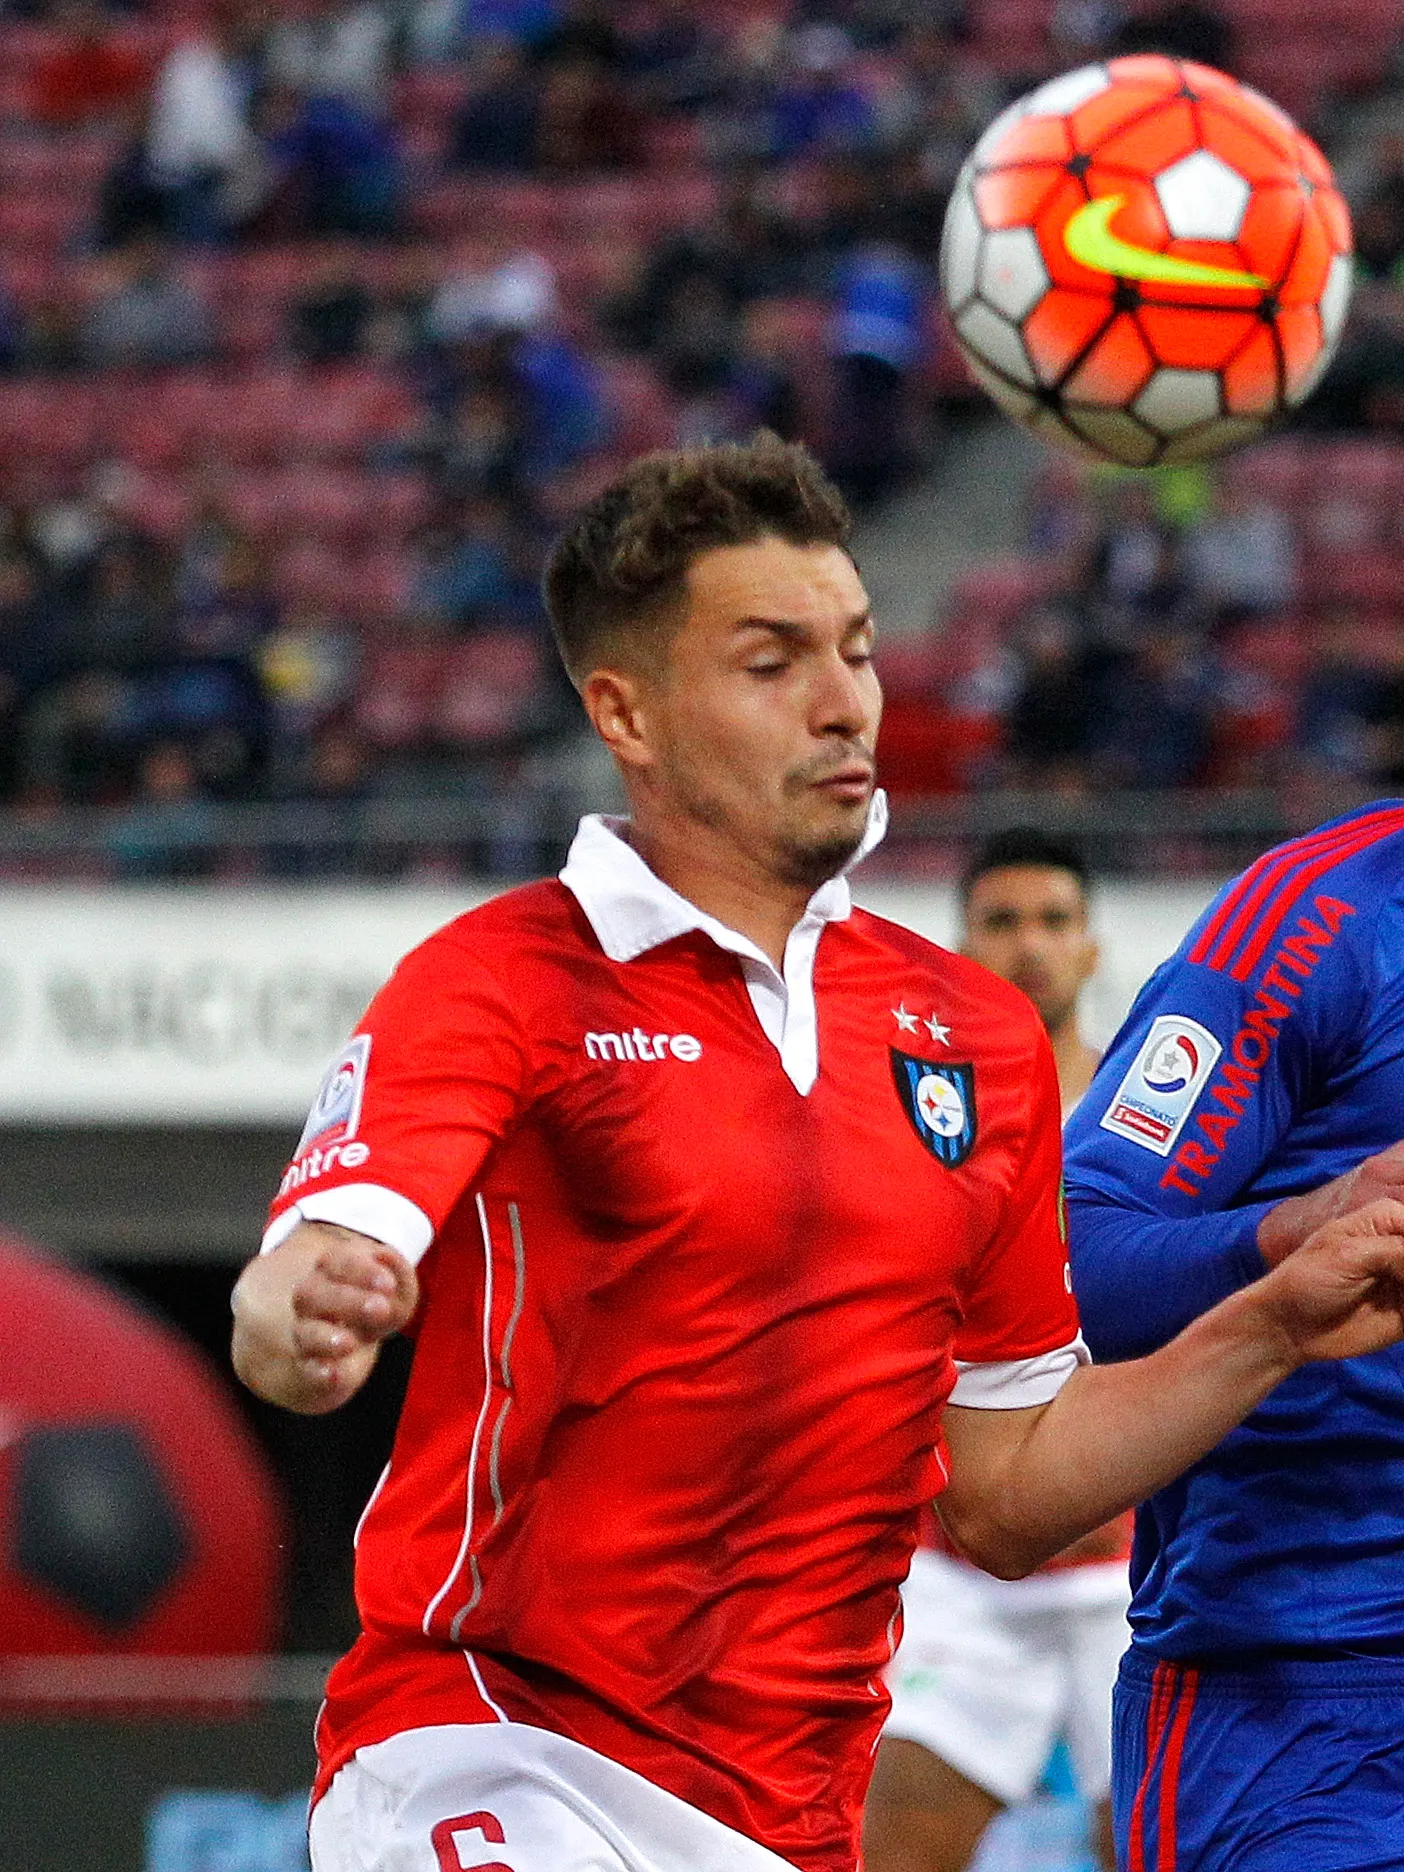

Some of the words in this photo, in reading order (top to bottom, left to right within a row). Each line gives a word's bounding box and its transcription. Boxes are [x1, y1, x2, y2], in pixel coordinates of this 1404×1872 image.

[584, 1027, 703, 1062] mitre
[1158, 895, 1357, 1198] TRAMONTINA
[274, 1142, 371, 1200] mitre
